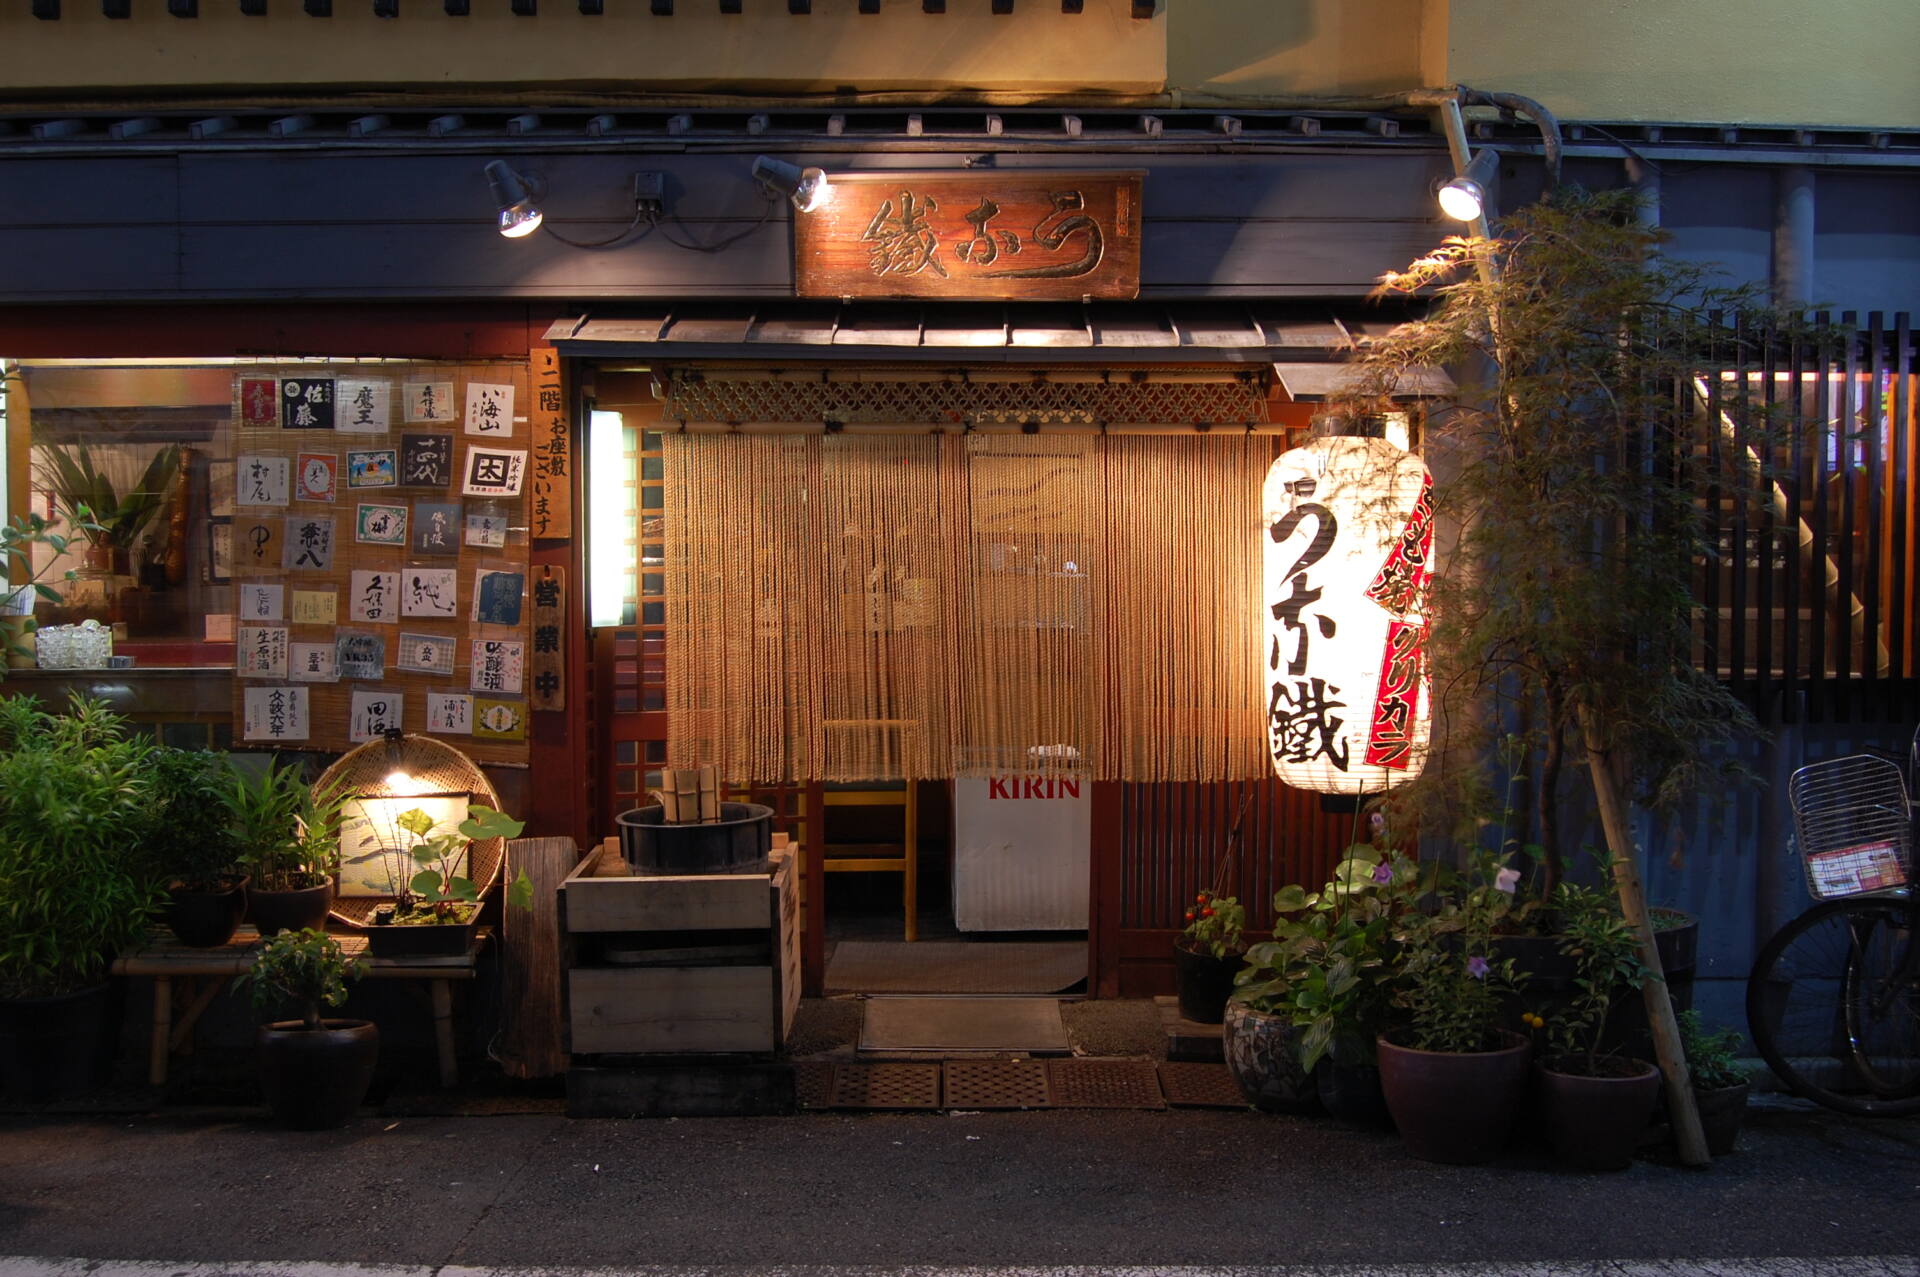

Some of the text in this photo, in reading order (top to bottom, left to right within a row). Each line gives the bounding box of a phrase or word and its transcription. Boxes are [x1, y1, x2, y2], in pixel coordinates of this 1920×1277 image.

[295, 384, 324, 426] 佐藤
[353, 386, 375, 425] 魔王
[479, 389, 502, 431] 八海山
[539, 369, 560, 412] 二階
[250, 459, 271, 501] 村尾
[413, 438, 438, 484] 十四代
[479, 459, 502, 480] 太
[534, 444, 552, 536] ございます
[362, 575, 385, 619] 久保田
[257, 629, 270, 670] 生原酒
[269, 689, 286, 738] 文政六年
[1371, 624, 1419, 767] クリカラ
[367, 701, 386, 736] 田酒
[989, 774, 1079, 799] KIRIN
